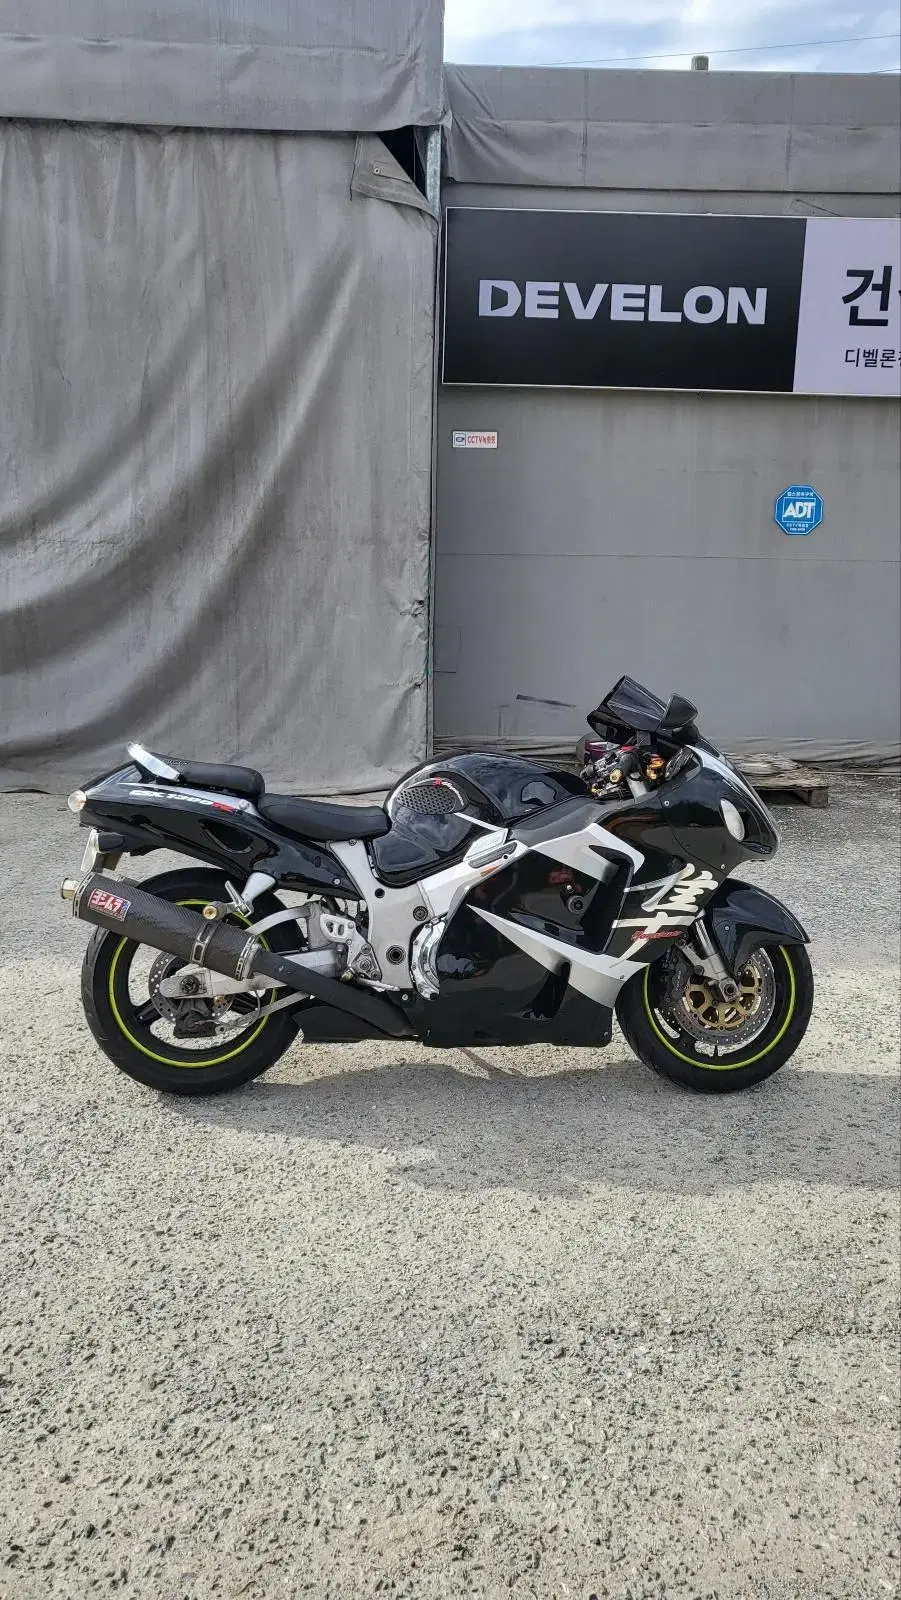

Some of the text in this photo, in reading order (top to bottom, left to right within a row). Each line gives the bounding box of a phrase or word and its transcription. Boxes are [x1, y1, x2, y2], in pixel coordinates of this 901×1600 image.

[478, 279, 768, 325] DEVELON
[842, 265, 901, 326] 건
[782, 501, 816, 519] ADT
